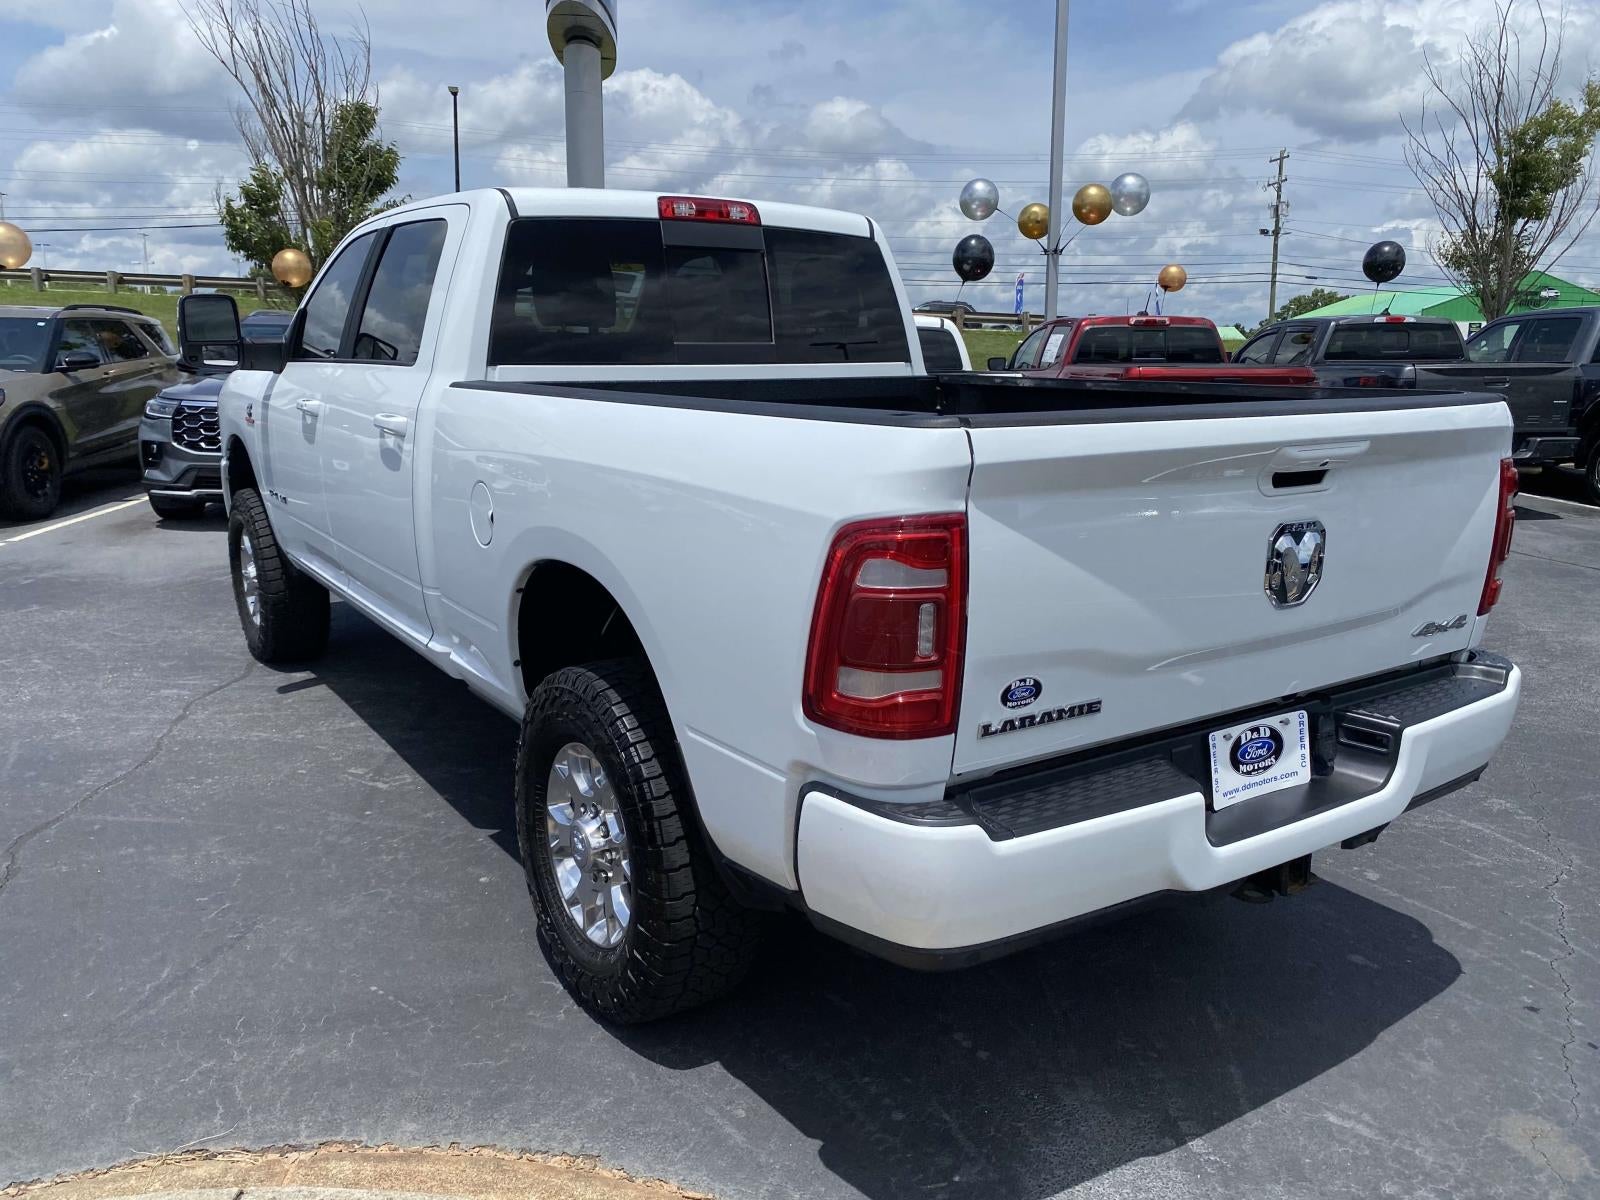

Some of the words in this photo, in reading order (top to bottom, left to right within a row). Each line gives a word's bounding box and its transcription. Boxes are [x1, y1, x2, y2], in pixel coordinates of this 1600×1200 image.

[1011, 678, 1034, 690] D&D
[1007, 697, 1035, 708] MOTORS
[1012, 688, 1031, 699] Ford
[977, 698, 1103, 740] LARAMIE
[1241, 726, 1271, 744] D&D
[1298, 712, 1306, 751] GREER
[1245, 742, 1269, 760] Ford
[1239, 755, 1276, 774] MOTORS
[1300, 753, 1307, 768] SC
[1222, 770, 1299, 798] www.ddmotors.com
